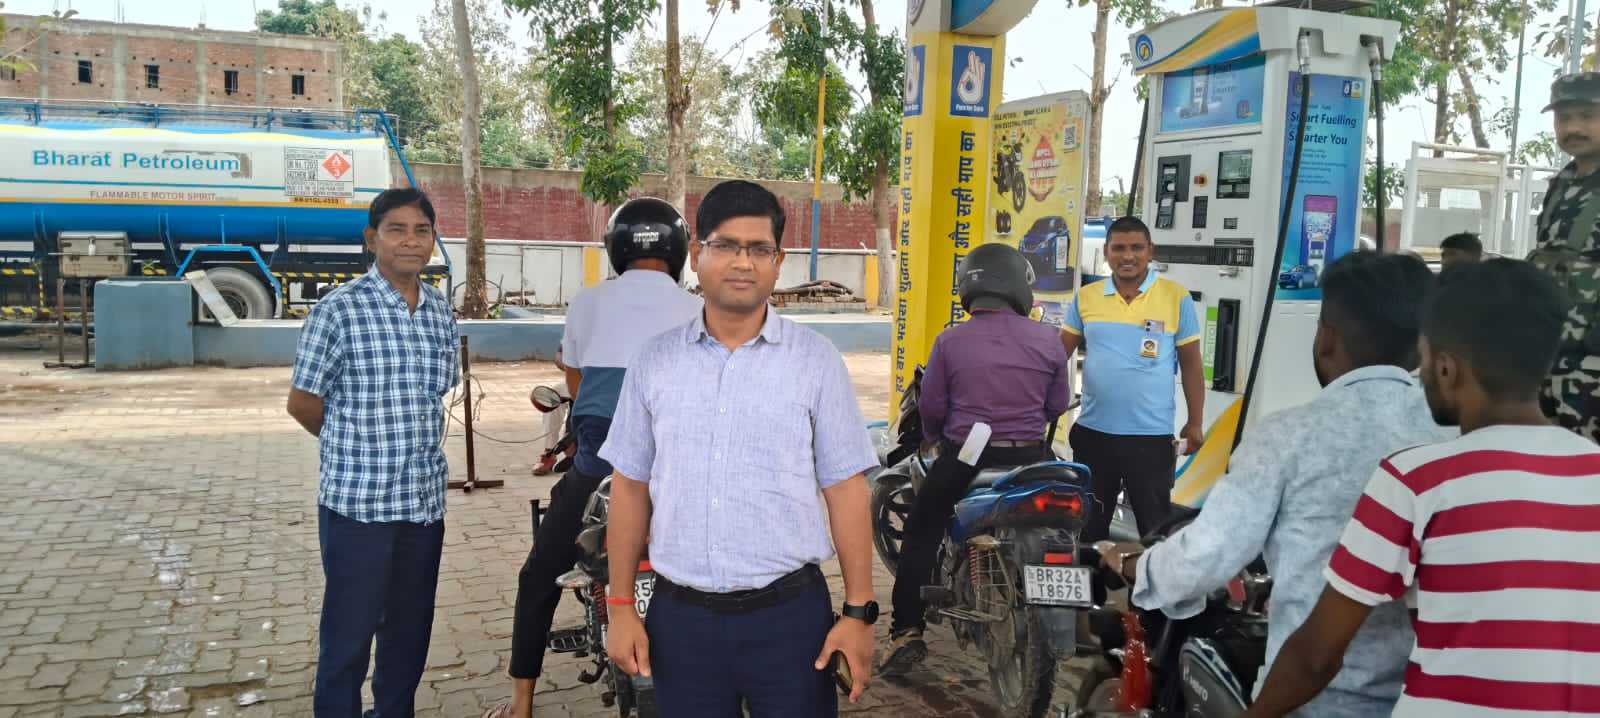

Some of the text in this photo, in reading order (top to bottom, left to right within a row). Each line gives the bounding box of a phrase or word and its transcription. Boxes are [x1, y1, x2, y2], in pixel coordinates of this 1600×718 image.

[1321, 114, 1357, 128] Fuelling
[959, 130, 976, 152] का
[1289, 131, 1348, 144] Sarter You
[33, 149, 241, 171] Bharat Petroleum
[957, 156, 975, 184] माप
[90, 190, 149, 200] FLAMMABLE
[151, 192, 184, 200] MOTOR
[187, 193, 216, 201] SPIRIT
[951, 186, 974, 217] सही
[947, 220, 971, 249] और
[1036, 568, 1082, 584] BR32A
[1038, 583, 1082, 599] T8676
